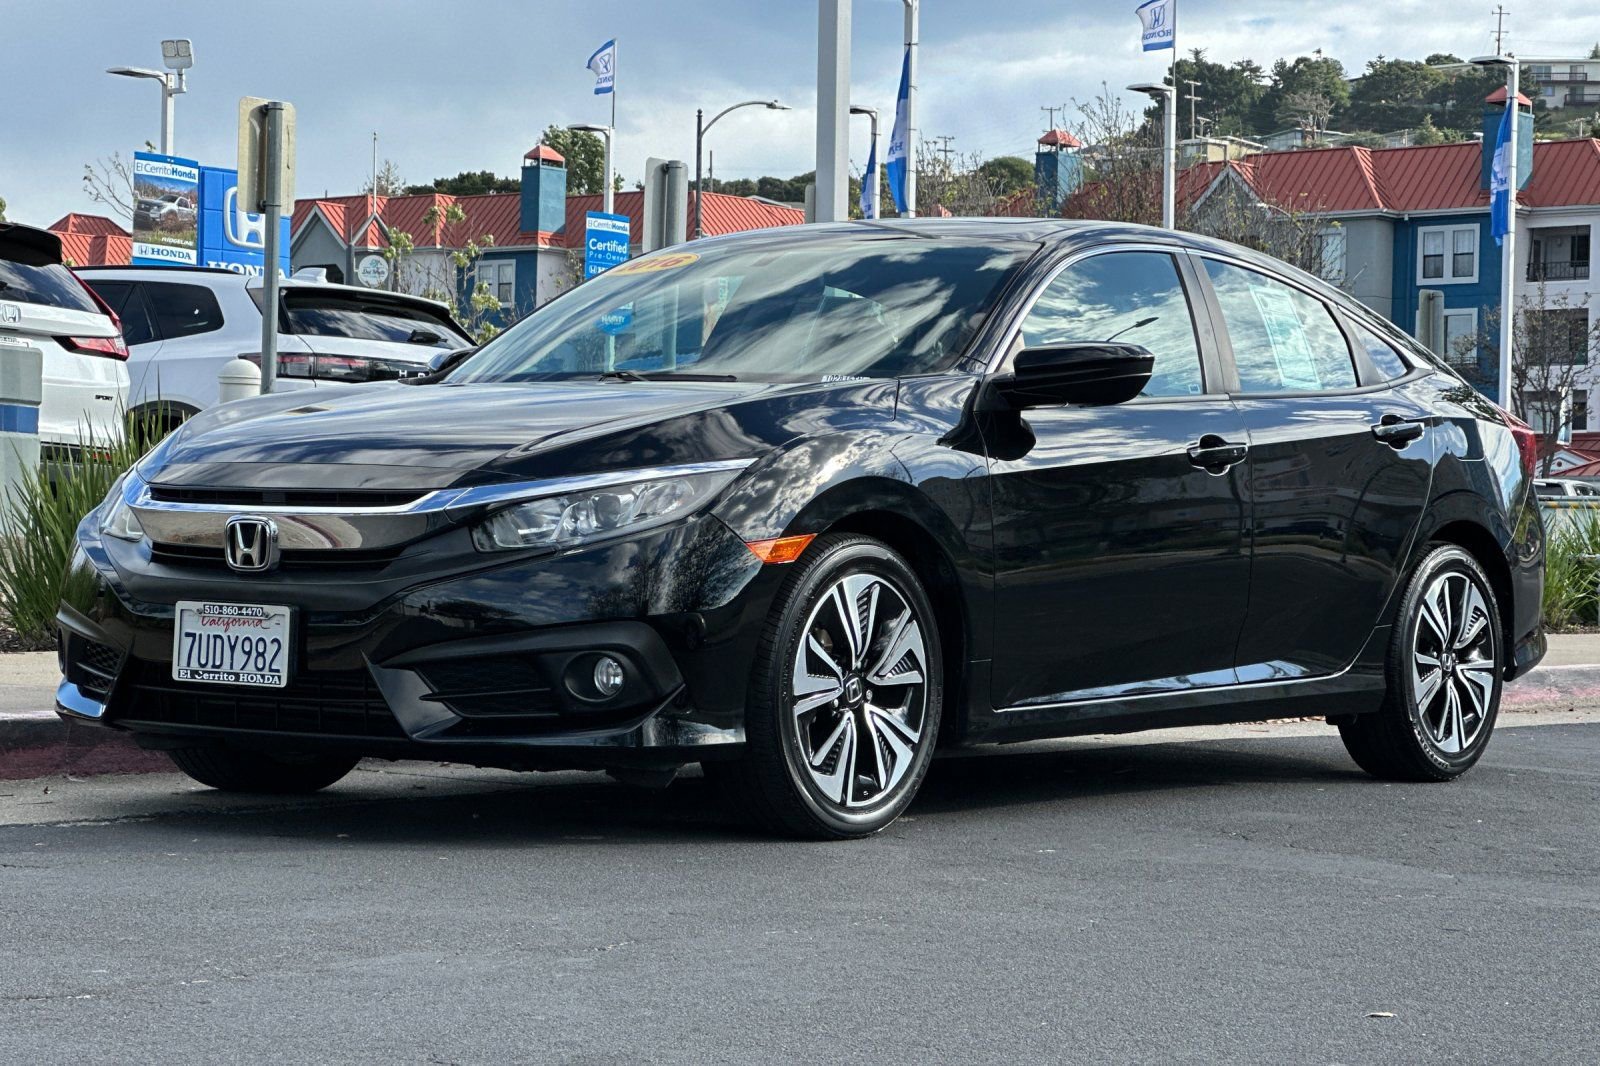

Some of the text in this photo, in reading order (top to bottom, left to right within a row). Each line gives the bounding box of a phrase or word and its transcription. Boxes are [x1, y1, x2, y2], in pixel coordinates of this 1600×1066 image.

[150, 247, 192, 260] HONDA
[589, 238, 628, 254] Certified
[204, 605, 263, 617] 510-860-4470
[184, 632, 282, 674] 7UDY982
[179, 669, 191, 679] El
[239, 673, 280, 685] HONDA
